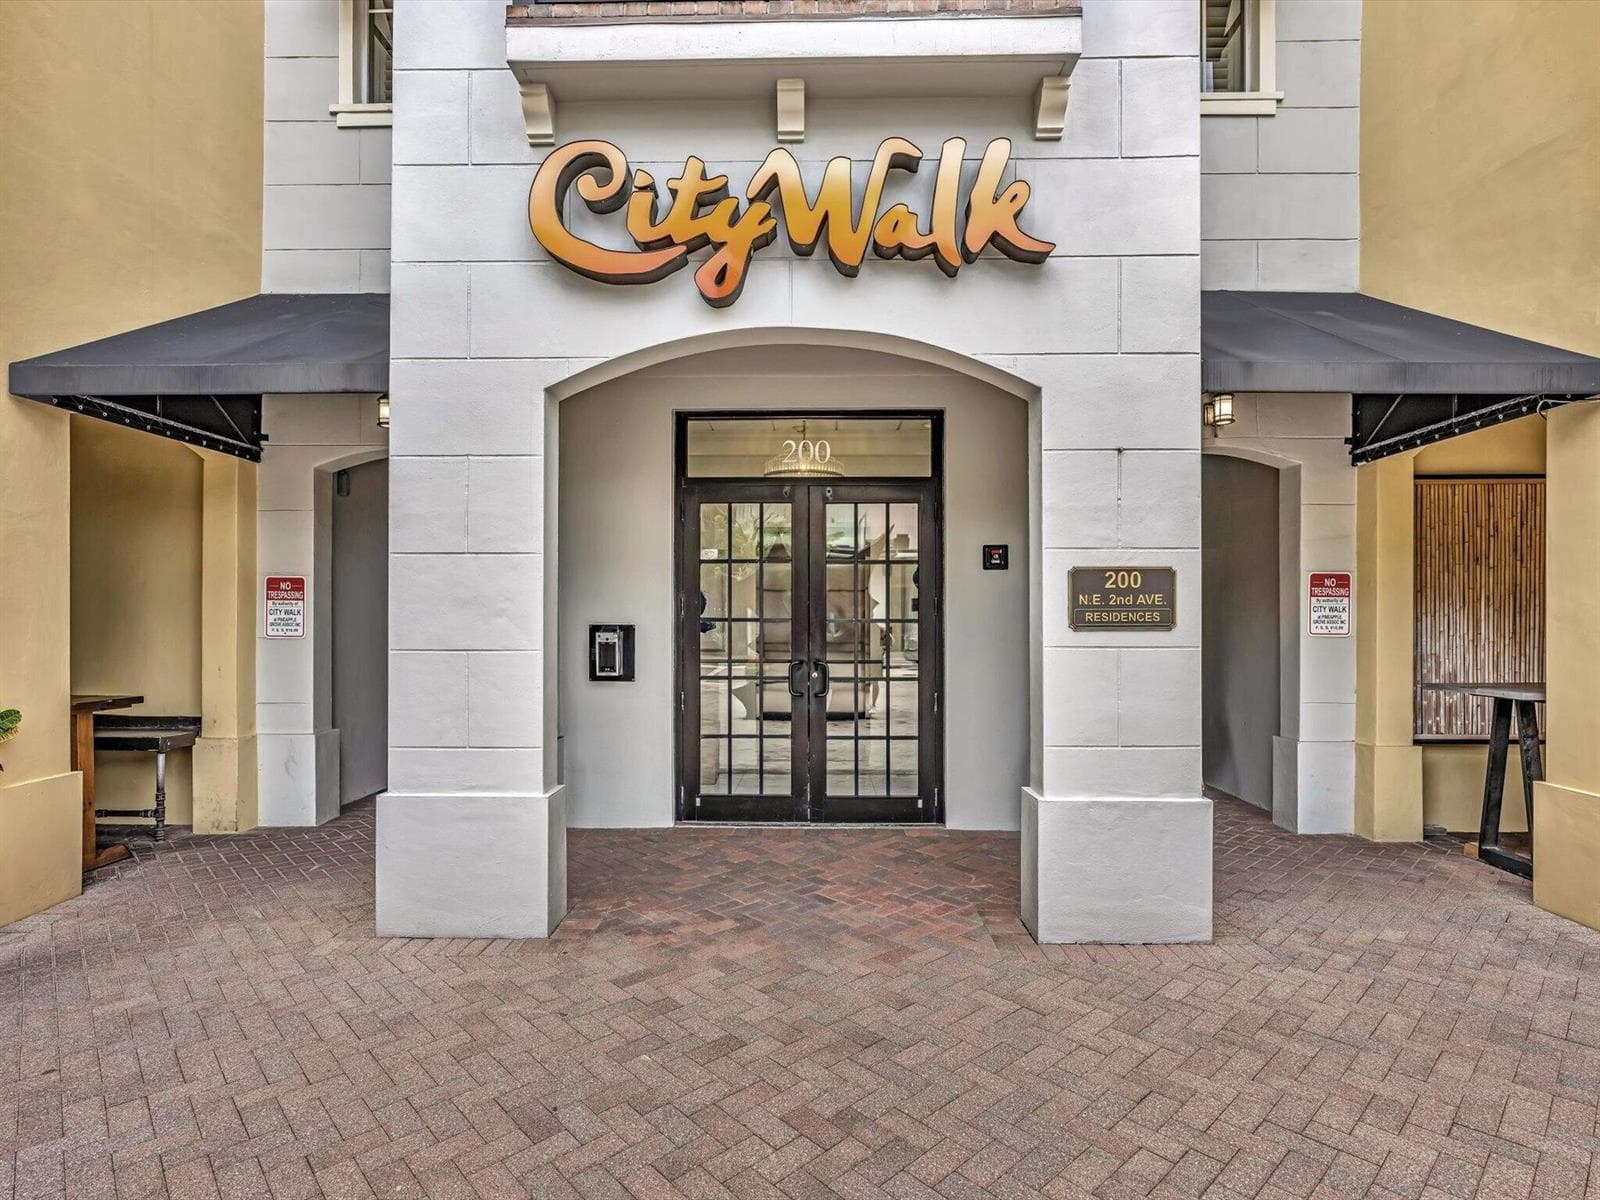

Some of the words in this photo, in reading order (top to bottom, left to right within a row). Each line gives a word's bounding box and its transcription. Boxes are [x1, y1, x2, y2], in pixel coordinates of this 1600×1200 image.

[782, 440, 831, 464] 200
[1104, 571, 1141, 588] 200
[1324, 578, 1336, 586] NO
[280, 582, 292, 590] NO
[268, 590, 303, 599] TRESPASSING
[1312, 587, 1350, 596] TRESPASSING
[1079, 594, 1104, 605] N.E.
[1108, 594, 1133, 605] 2nd
[1136, 594, 1167, 605] AVE.
[1085, 612, 1160, 622] RESIDENCES
